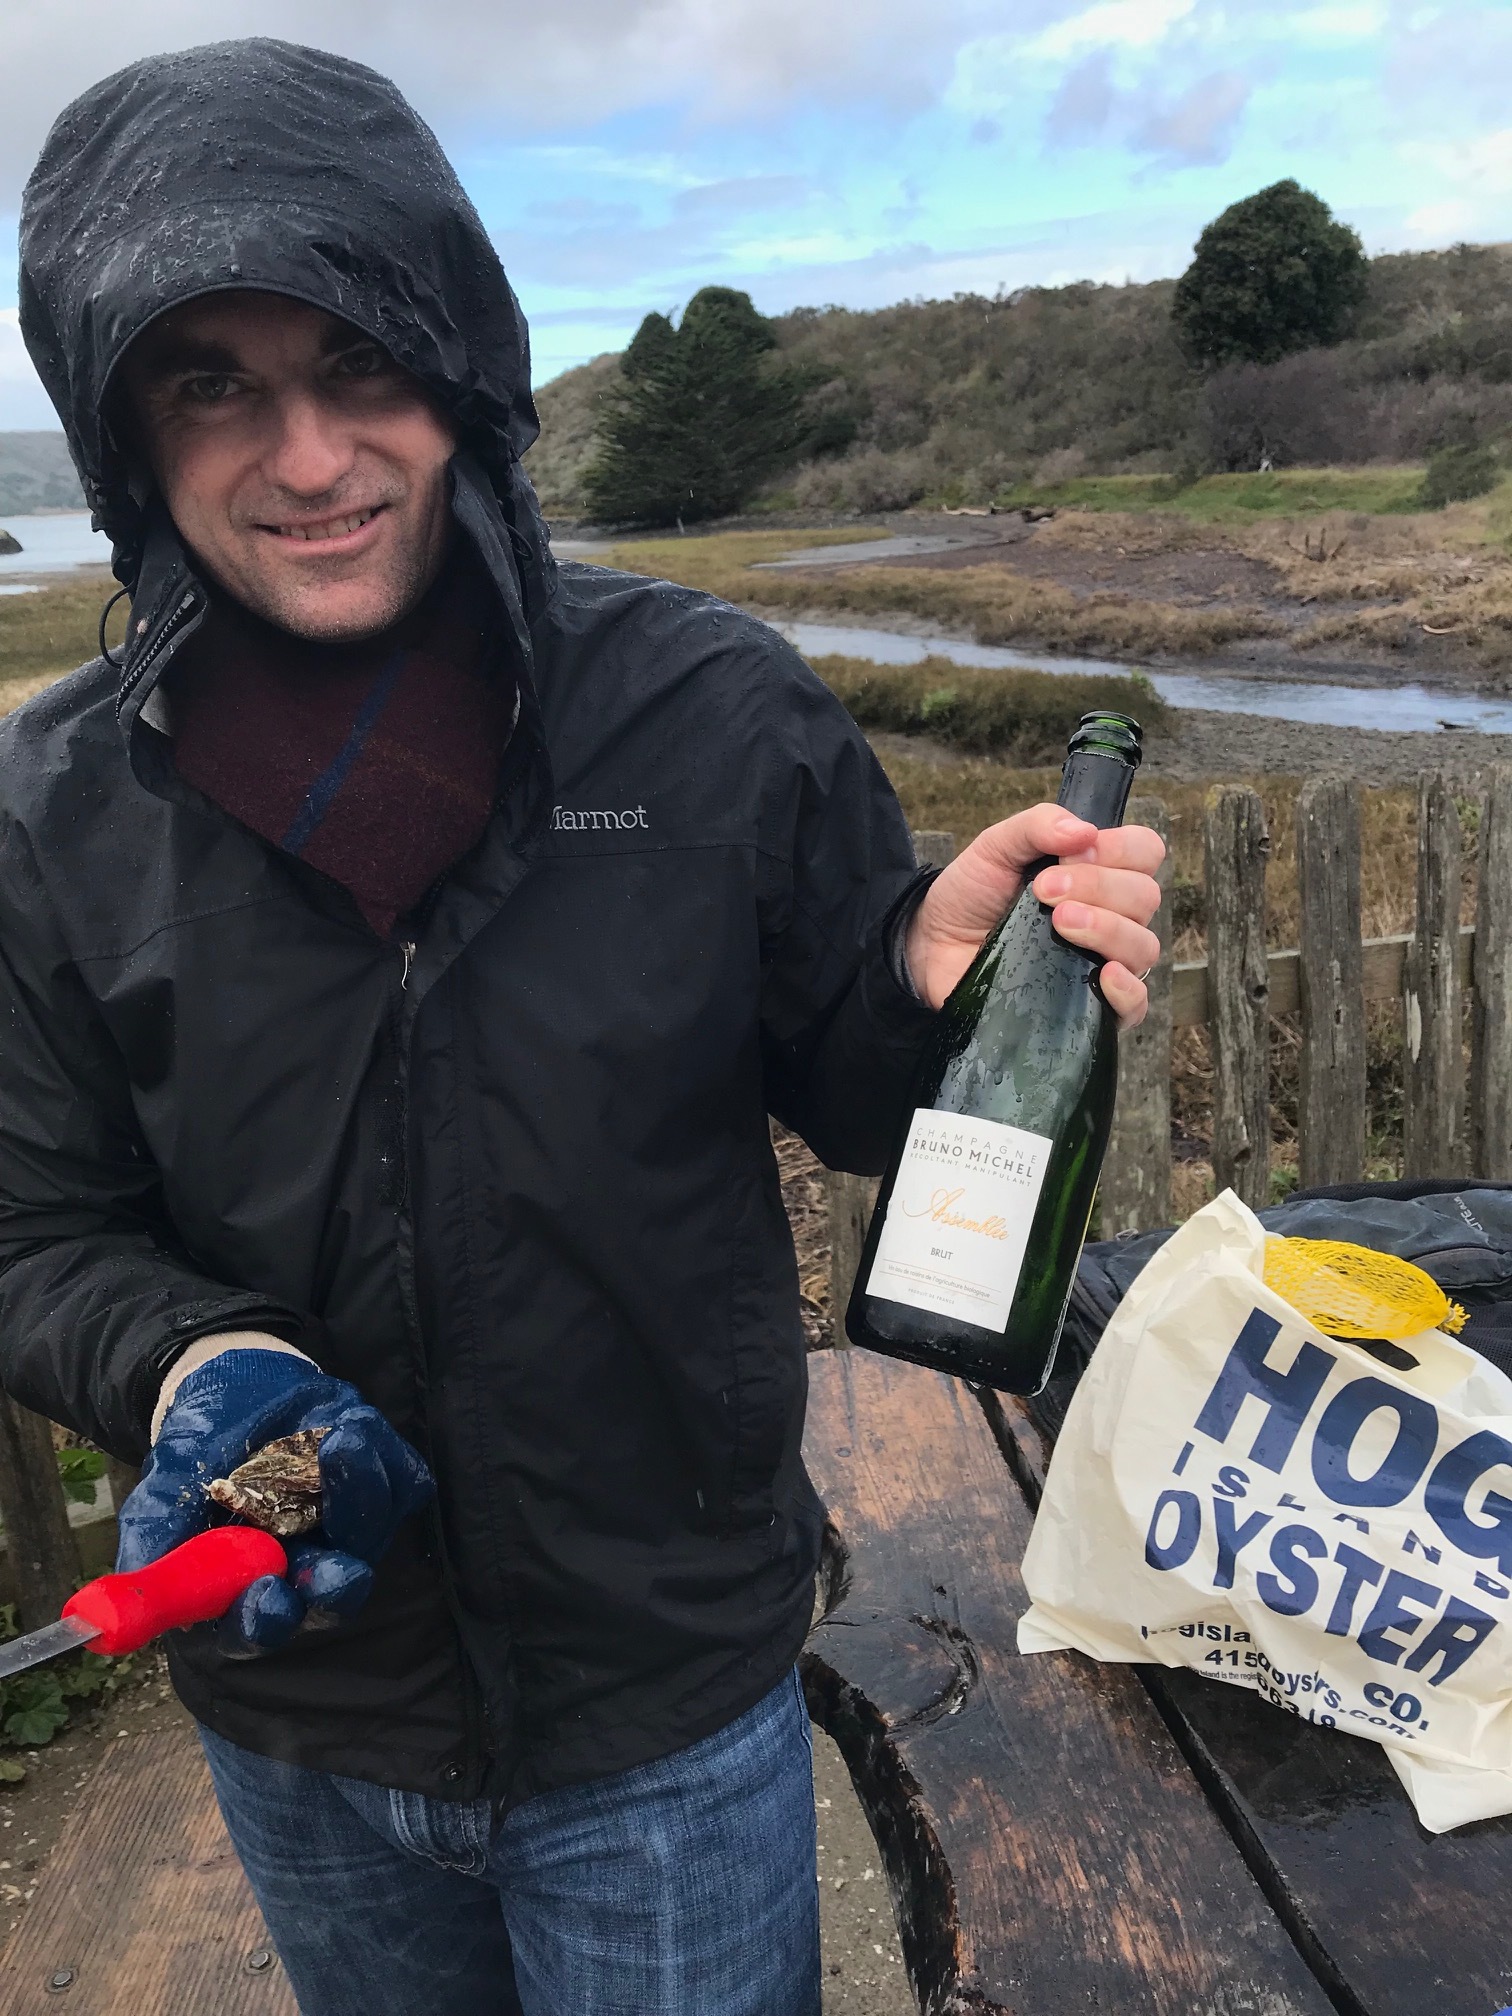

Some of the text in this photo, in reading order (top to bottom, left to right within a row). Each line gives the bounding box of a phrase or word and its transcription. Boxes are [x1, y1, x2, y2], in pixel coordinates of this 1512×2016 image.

[912, 1139, 1033, 1178] BRUNO MICHEL
[917, 1128, 1037, 1165] CHAMPAGNE
[910, 1151, 1031, 1187] RÉCOLTANT MANIPULANT
[930, 1247, 954, 1260] BRUT
[936, 1295, 955, 1305] FRANCE
[963, 1284, 990, 1299] biologique
[1193, 1306, 1512, 1580] HOG
[1172, 1441, 1510, 1600] ISLAND
[1145, 1489, 1499, 1687] OYSTER
[1204, 1649, 1258, 1668] 415
[1229, 1672, 1239, 1680] the
[1363, 1682, 1430, 1731] CO.
